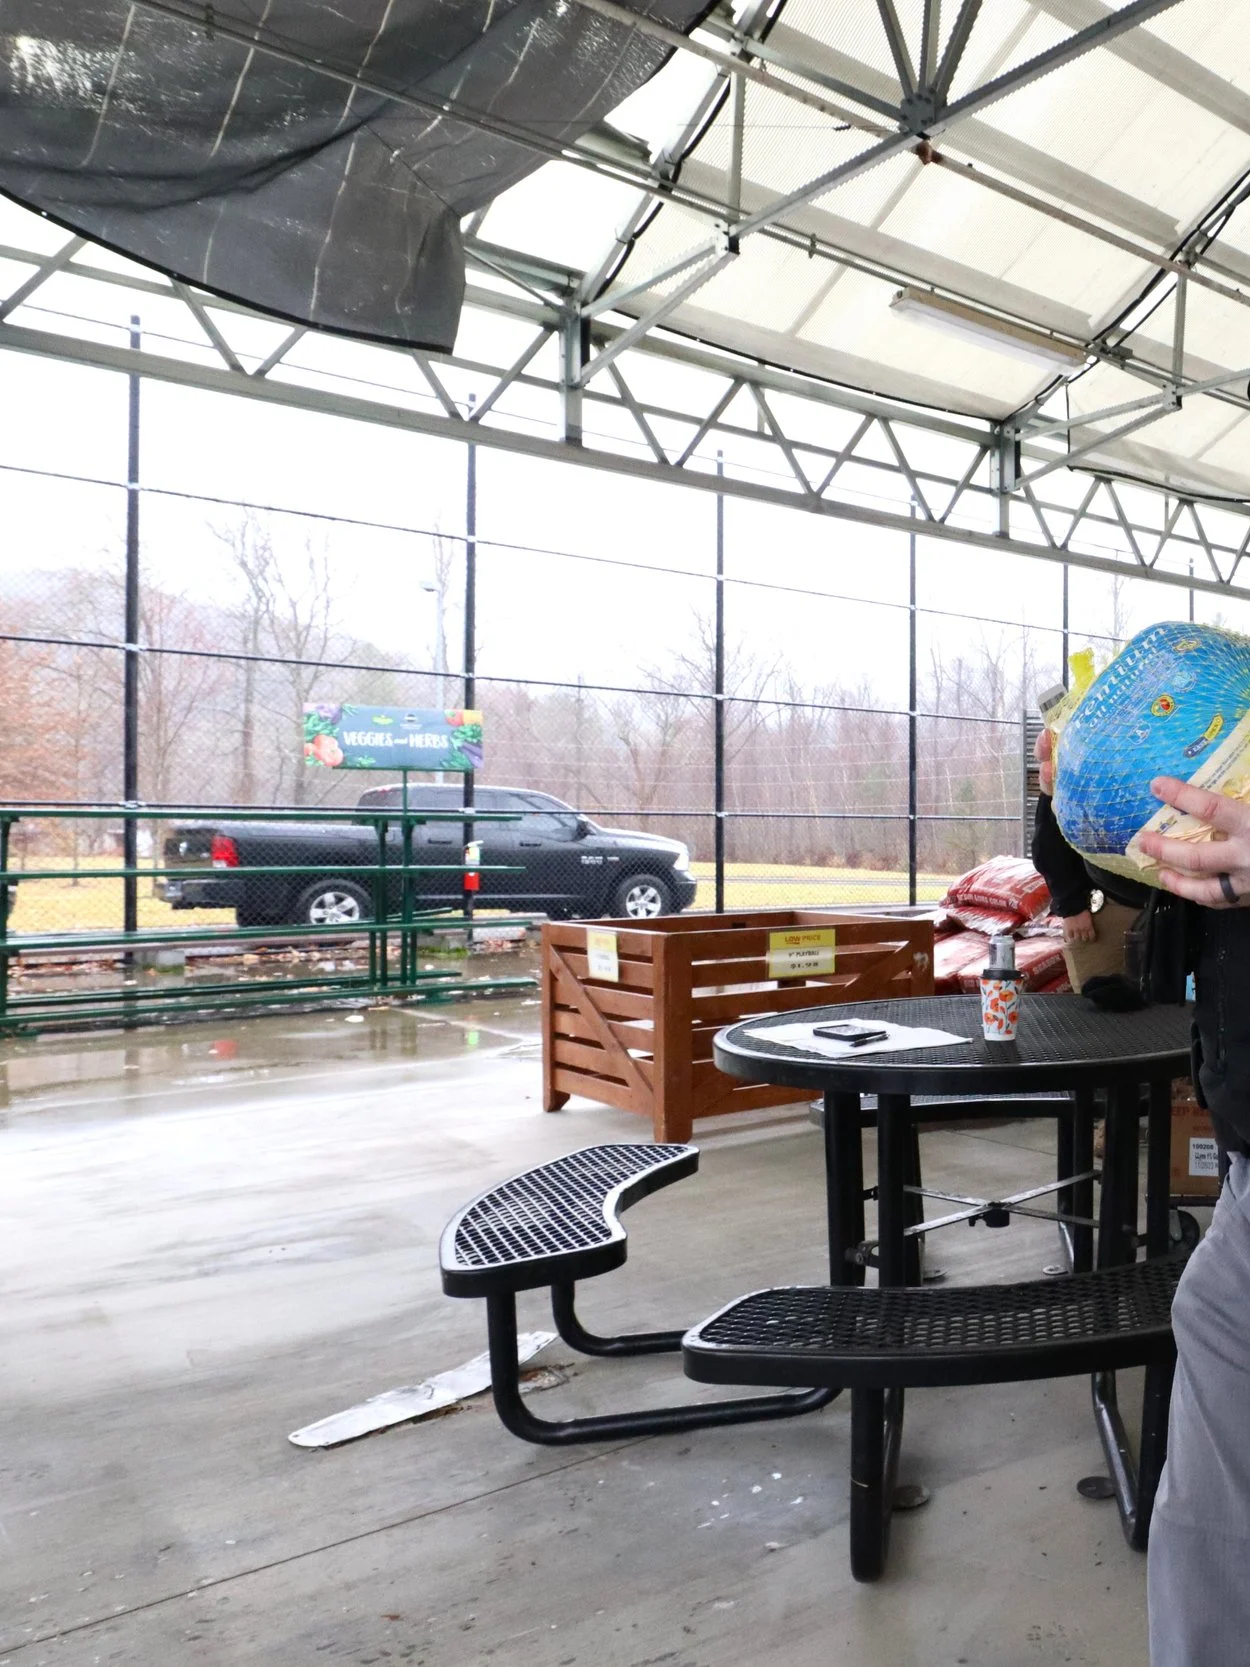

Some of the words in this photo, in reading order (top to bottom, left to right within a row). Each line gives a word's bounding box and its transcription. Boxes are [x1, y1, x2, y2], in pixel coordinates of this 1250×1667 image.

[1074, 626, 1169, 728] remium
[343, 731, 394, 747] VEGGIES
[394, 737, 408, 745] and
[409, 733, 449, 749] HERBS
[784, 935, 801, 944] LOW
[802, 934, 821, 942] PRICE
